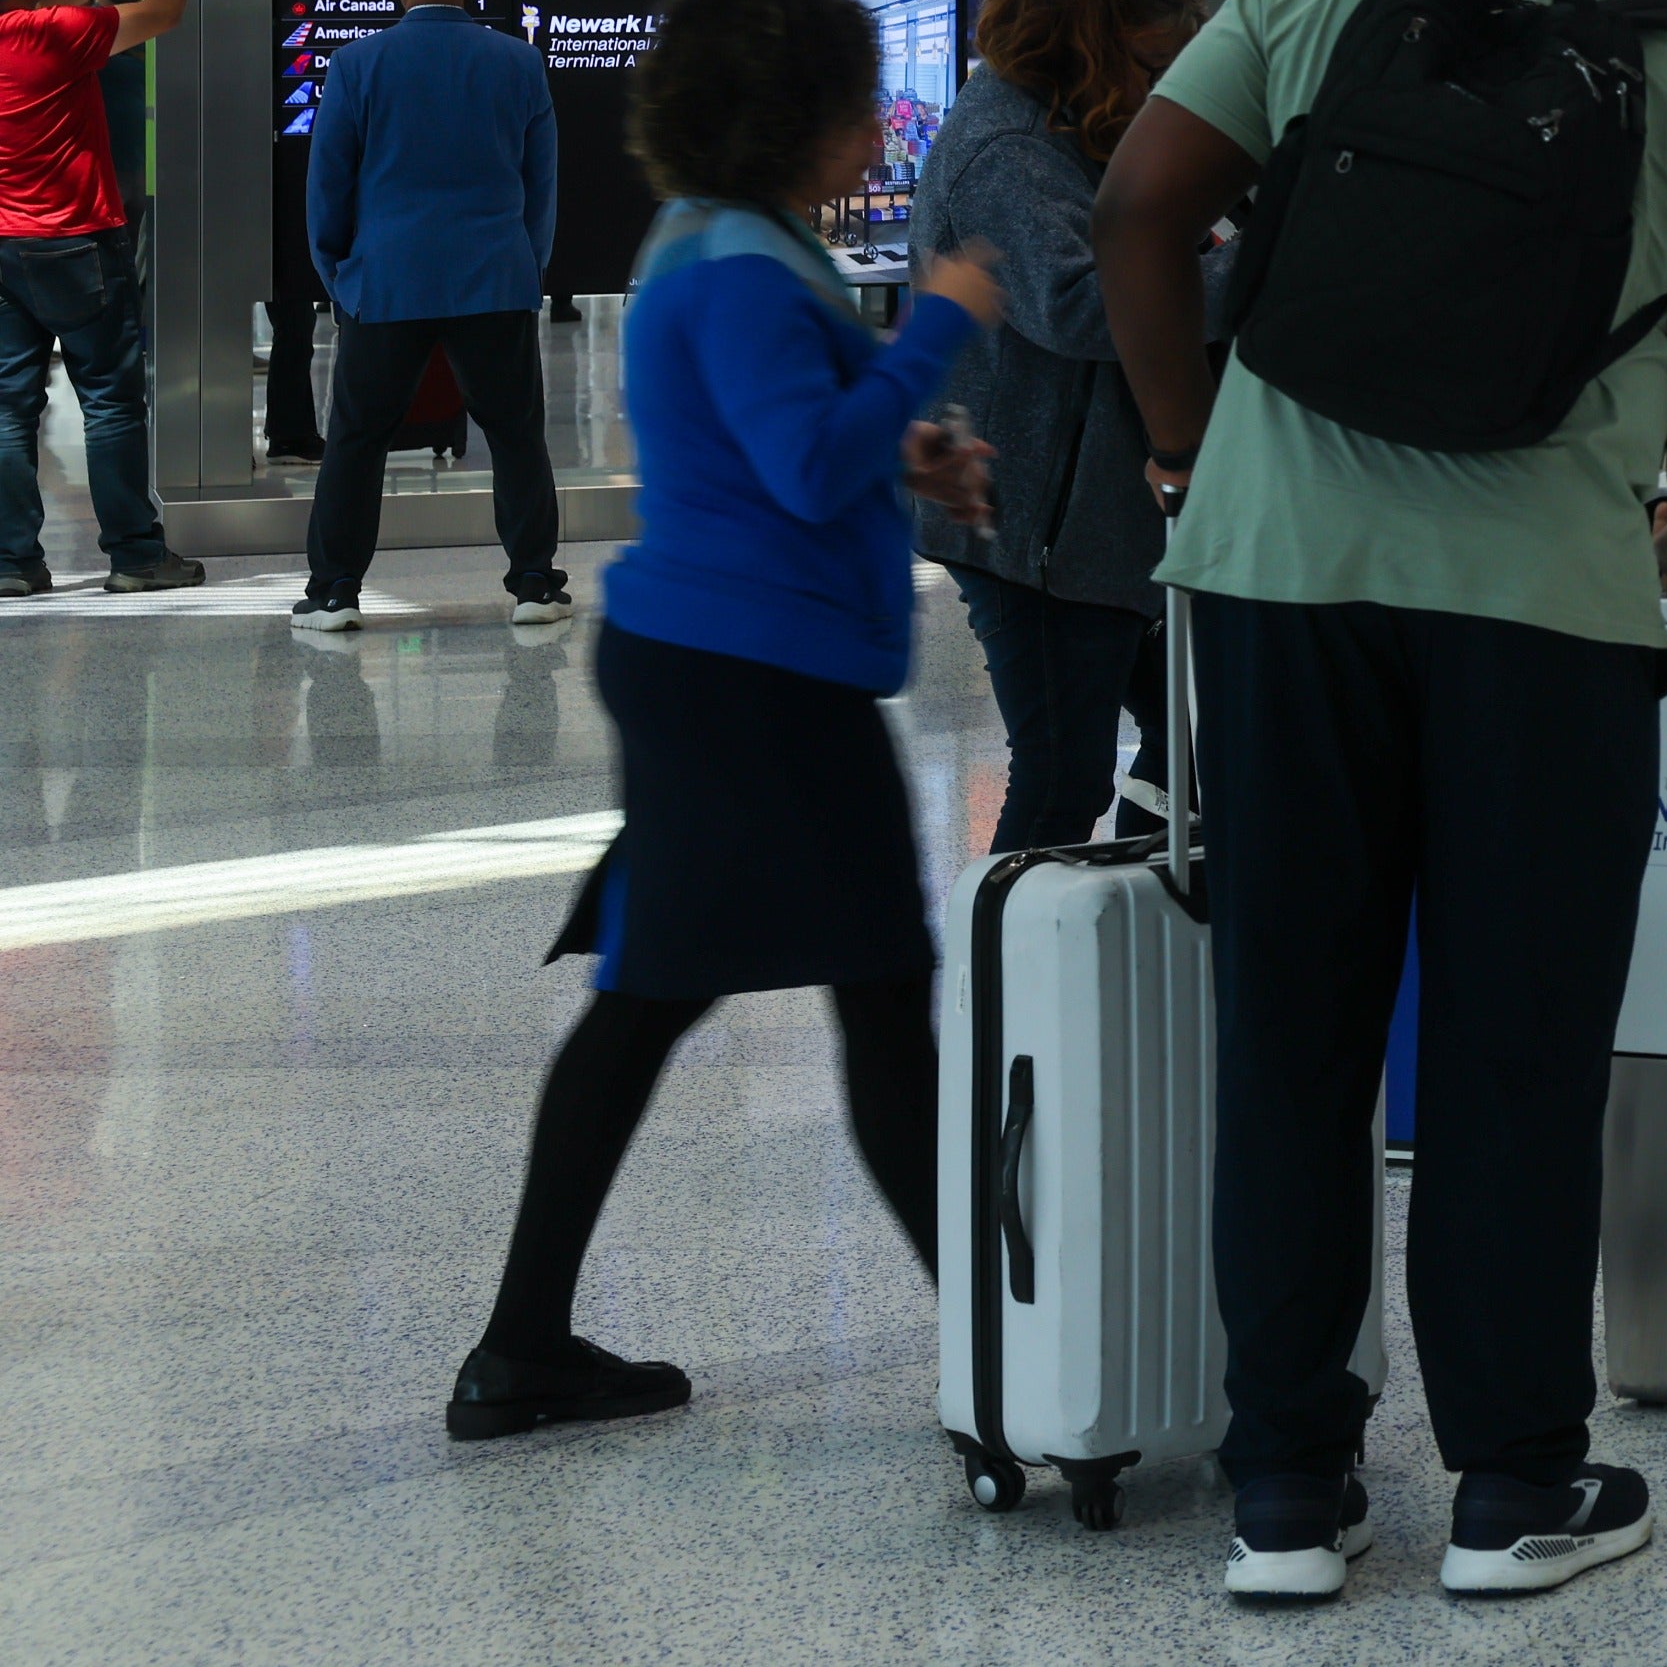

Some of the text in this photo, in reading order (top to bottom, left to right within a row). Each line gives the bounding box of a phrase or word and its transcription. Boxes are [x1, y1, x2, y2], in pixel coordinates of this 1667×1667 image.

[315, 0, 395, 12] Air Canada
[478, 0, 484, 10] 1
[549, 14, 641, 33] Newark
[549, 37, 650, 51] International
[548, 54, 635, 68] Terminal A
